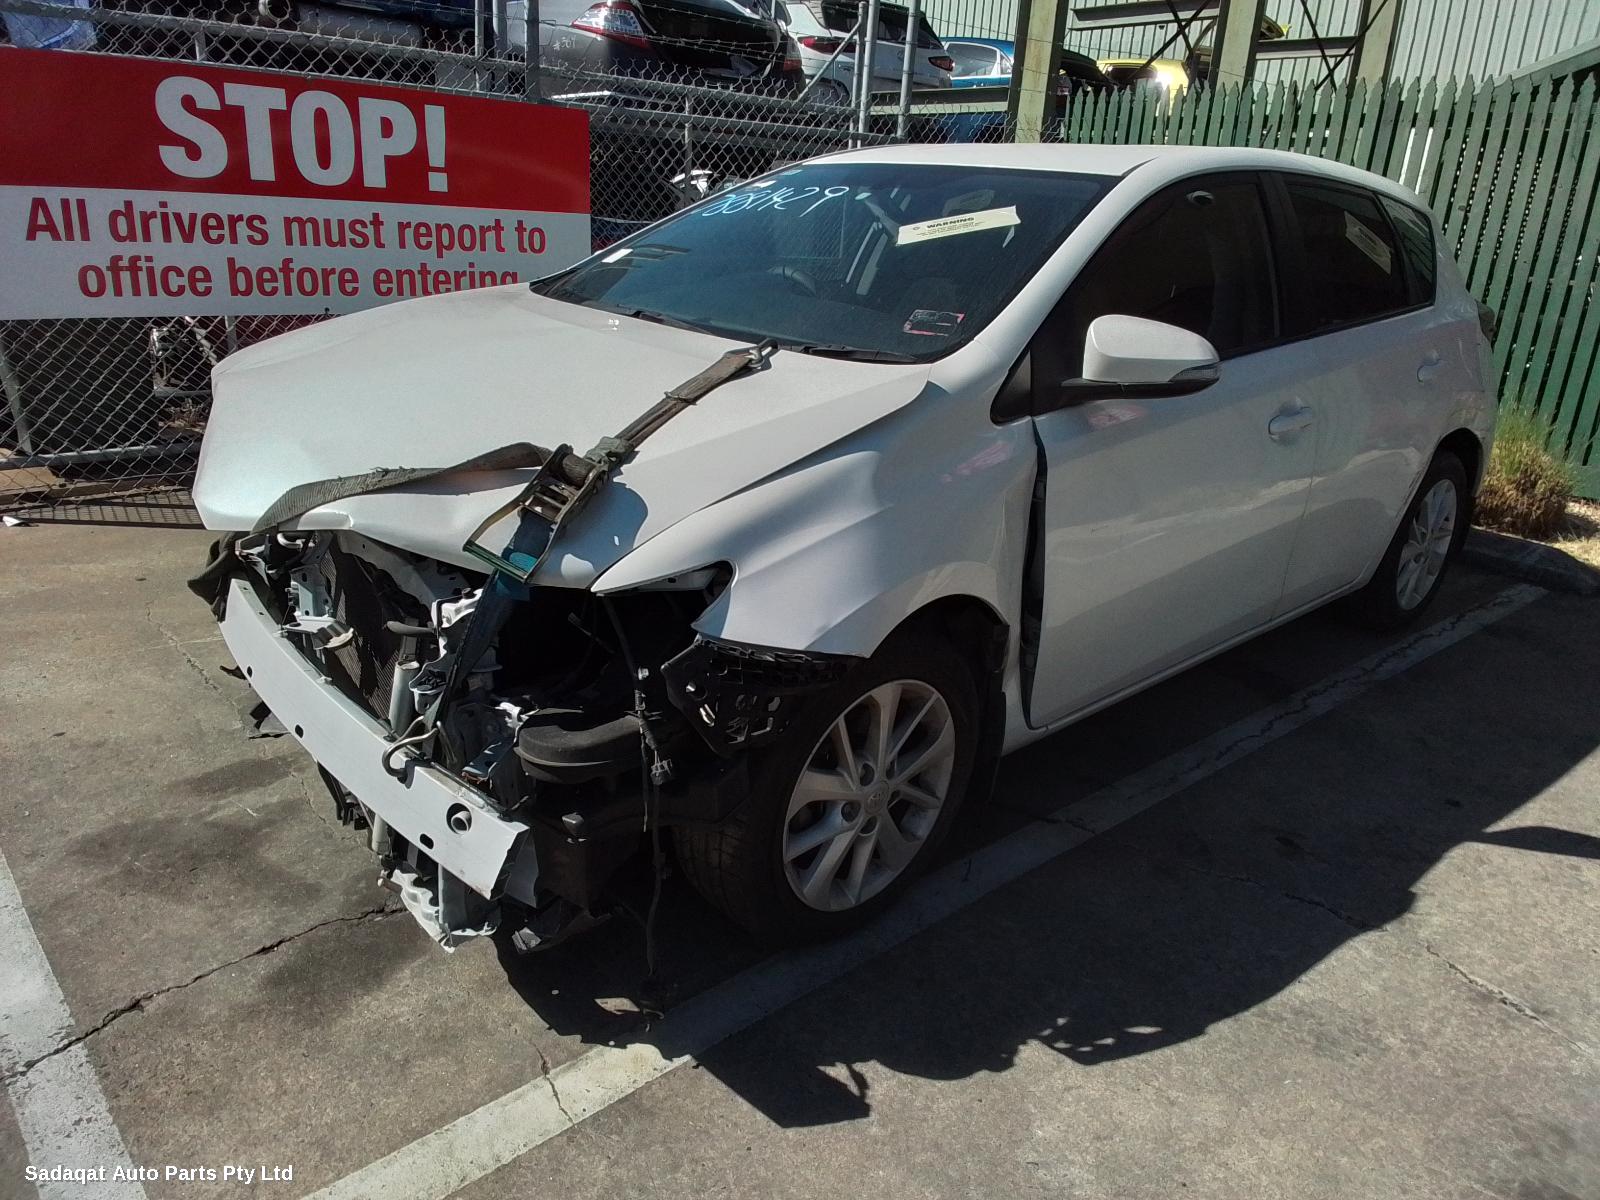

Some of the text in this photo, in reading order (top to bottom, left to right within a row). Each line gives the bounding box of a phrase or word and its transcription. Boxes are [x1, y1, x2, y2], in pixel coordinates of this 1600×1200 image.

[154, 75, 449, 193] STOP!
[27, 197, 547, 259] All drivers must report to
[78, 254, 212, 298] office
[227, 257, 360, 298] before
